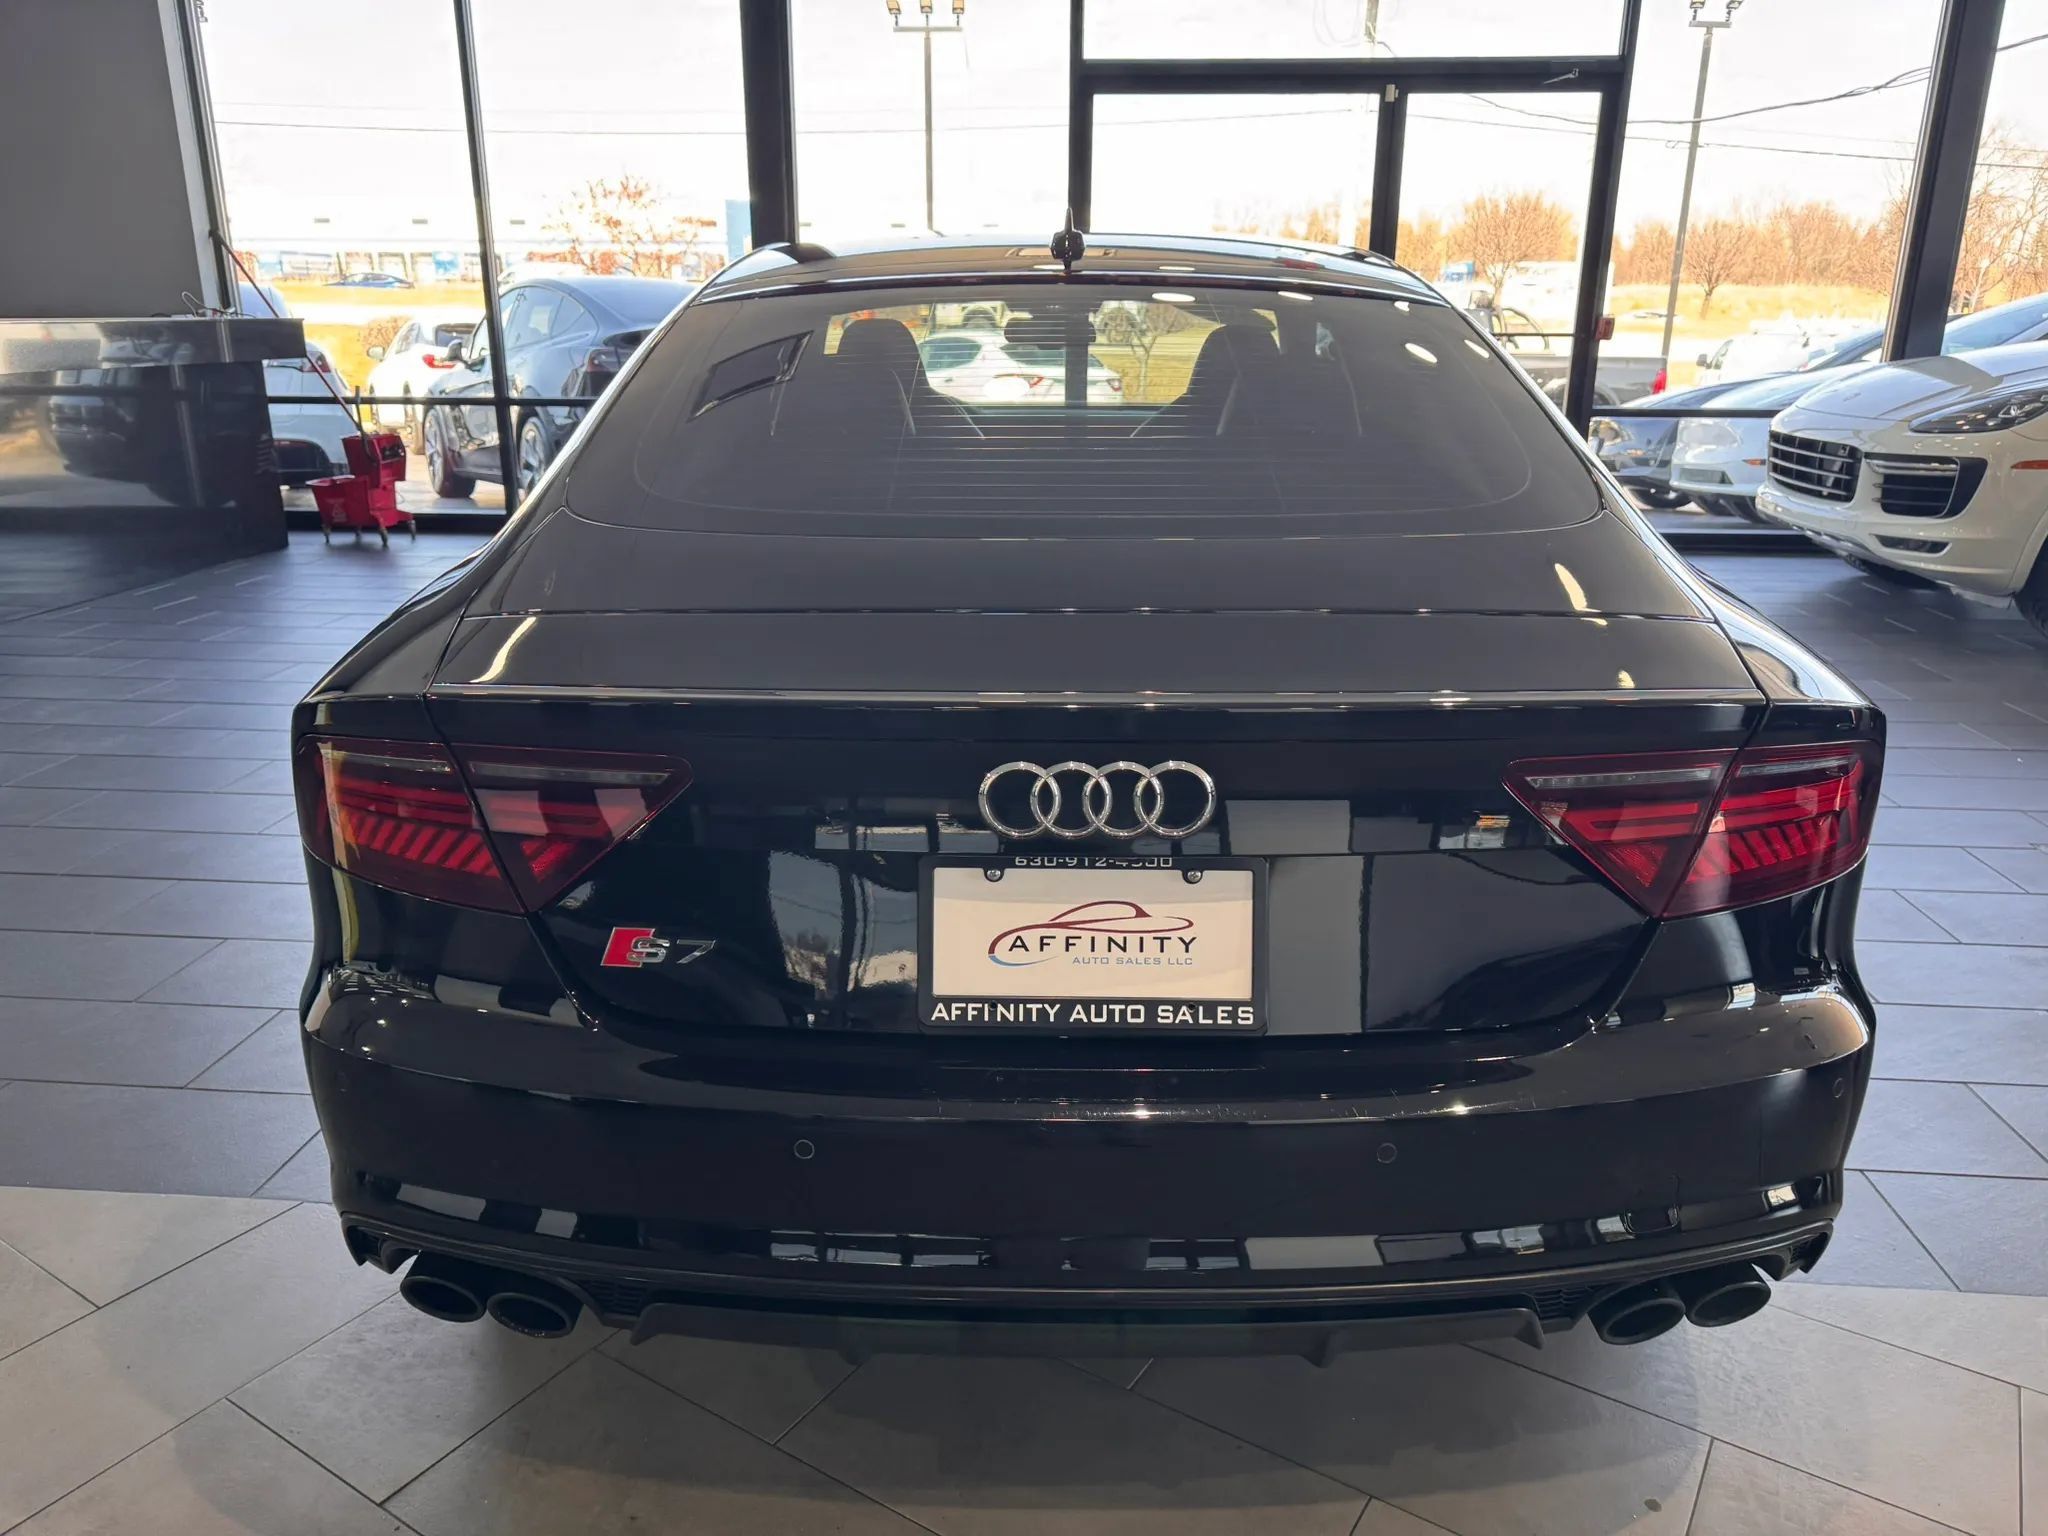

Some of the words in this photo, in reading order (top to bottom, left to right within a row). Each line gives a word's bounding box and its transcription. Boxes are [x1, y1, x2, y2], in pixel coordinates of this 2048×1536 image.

[626, 935, 717, 964] S7
[1008, 935, 1197, 953] AFFINITY
[1072, 956, 1110, 965] AUTO
[1116, 956, 1161, 966] SALES
[1167, 957, 1193, 966] LLC
[930, 1002, 1061, 1023] AFFINITY
[1069, 1003, 1145, 1024] AUTO
[1156, 1005, 1254, 1025] SALES
